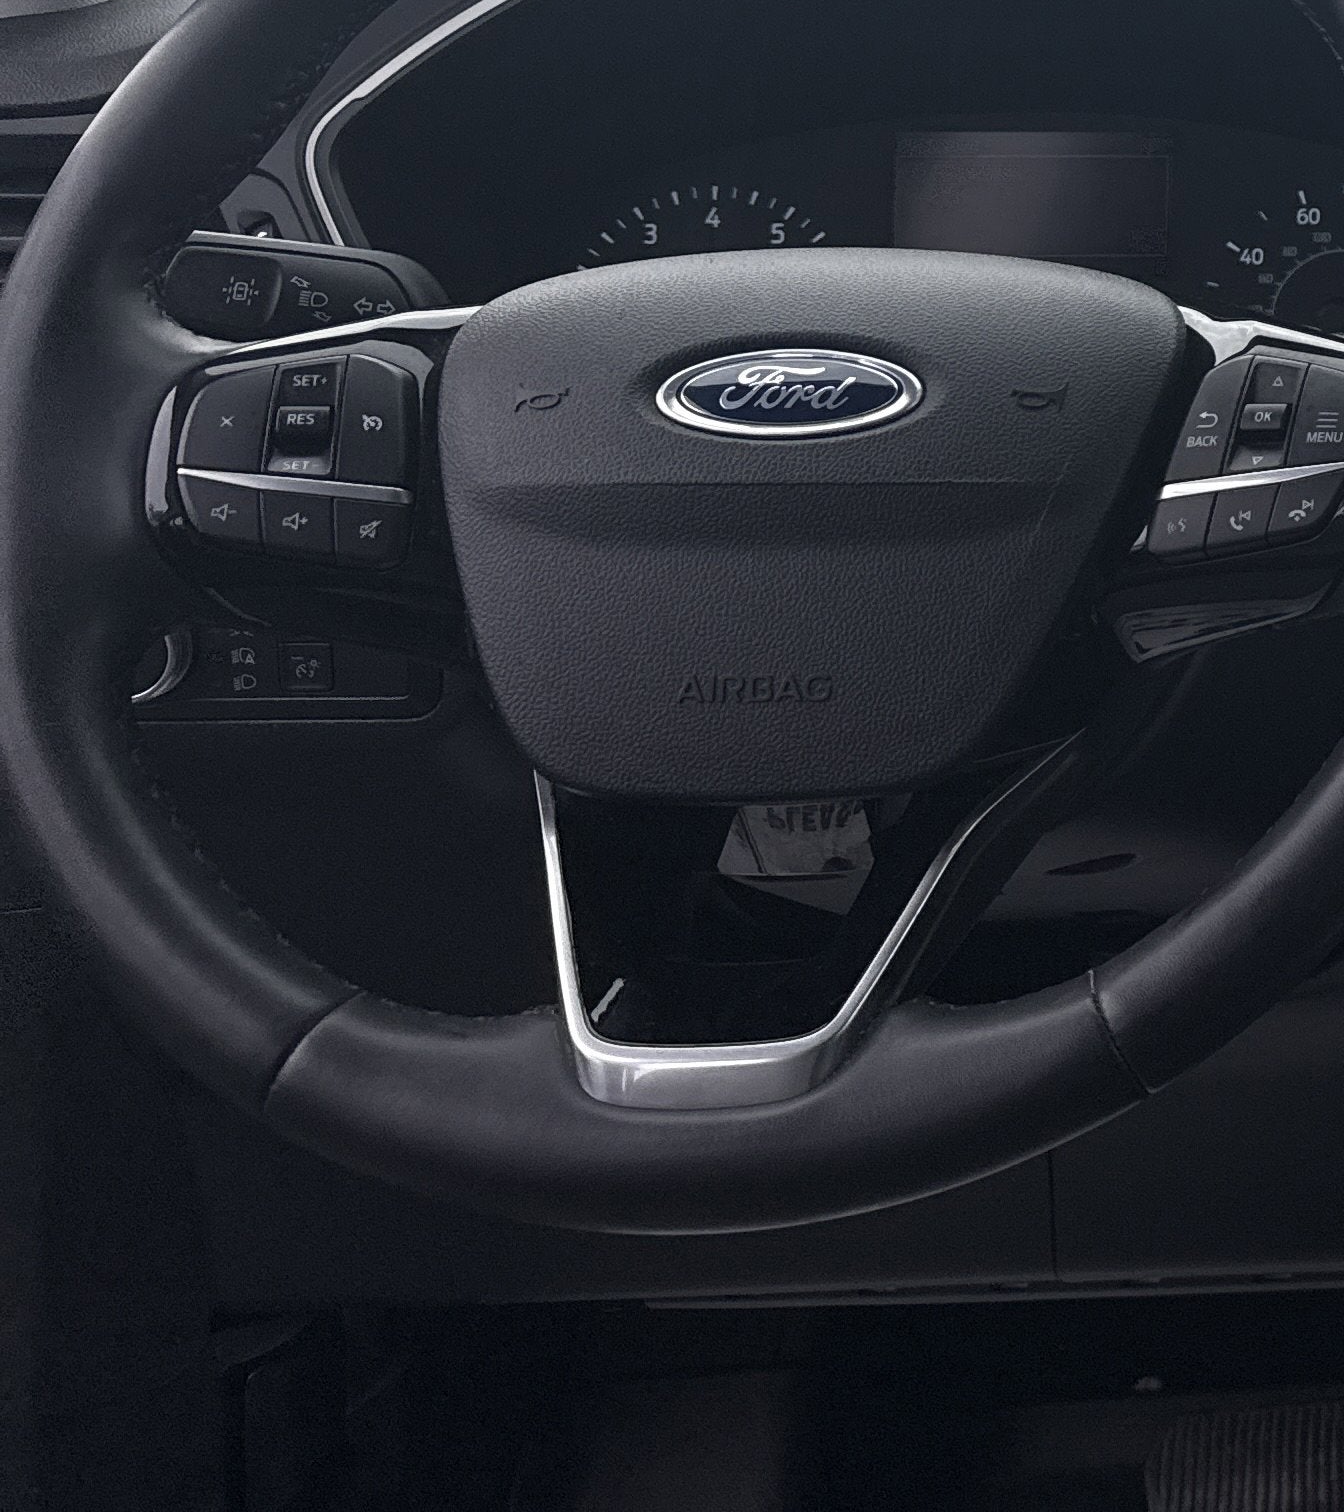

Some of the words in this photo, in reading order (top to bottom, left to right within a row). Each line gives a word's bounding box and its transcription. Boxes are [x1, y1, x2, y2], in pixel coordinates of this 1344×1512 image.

[704, 207, 721, 228] 4
[1296, 208, 1321, 225] 60
[643, 223, 658, 245] 3
[770, 223, 785, 244] 5
[1239, 248, 1265, 266] 40
[719, 365, 857, 410] Ford
[286, 413, 316, 425] RES
[1254, 411, 1273, 423] OK
[1186, 436, 1218, 448] BACK
[1306, 431, 1344, 444] MENU
[678, 673, 833, 704] AIRBAG
